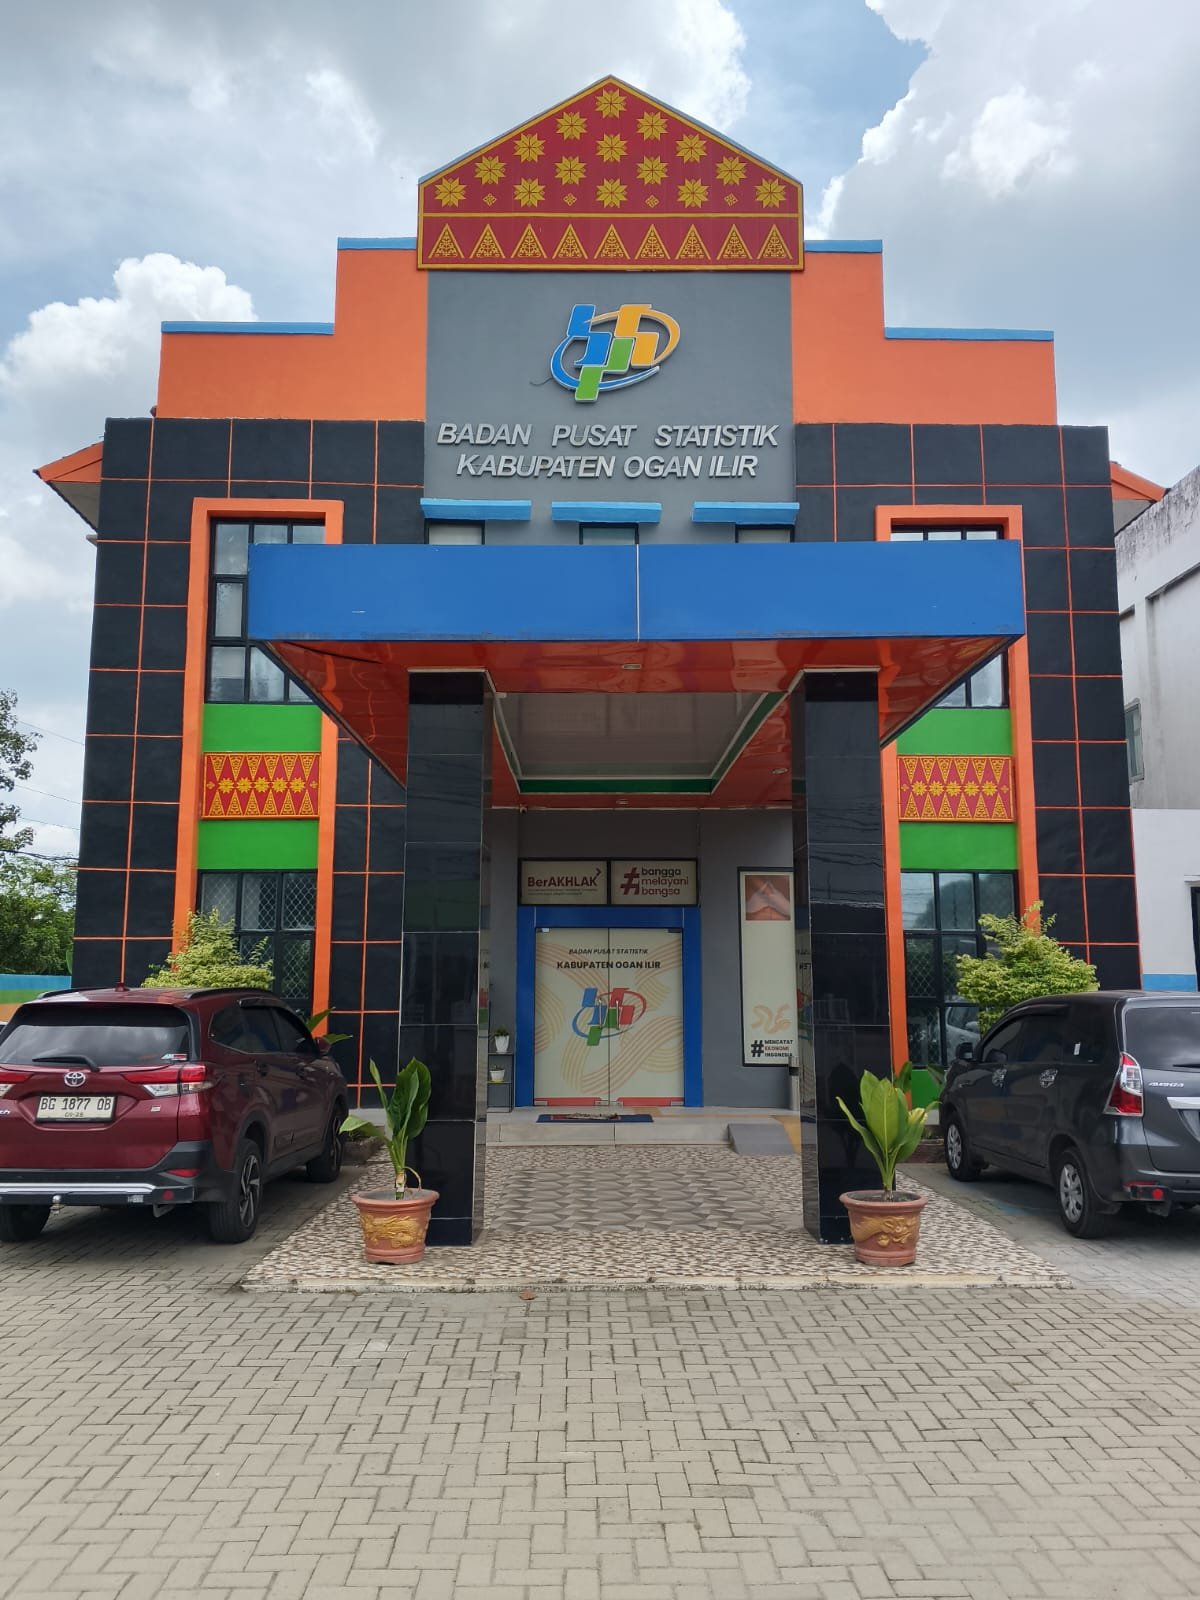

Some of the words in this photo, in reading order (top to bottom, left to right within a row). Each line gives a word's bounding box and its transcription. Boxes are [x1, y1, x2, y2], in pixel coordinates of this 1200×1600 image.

[436, 422, 532, 446] BADAN
[551, 423, 638, 448] PUSAT
[654, 424, 780, 448] STATISTIK
[456, 453, 616, 479] KABUPATEN
[623, 455, 703, 479] OGAN
[708, 455, 759, 478] ILIR
[641, 866, 681, 878] bangga
[527, 876, 597, 888] BerAKHLAK
[641, 876, 689, 888] melayani
[641, 886, 681, 898] bangsa
[557, 961, 613, 969] KABUPATEN
[615, 961, 643, 969] OGAN
[644, 961, 661, 969] ILIR
[41, 1098, 56, 1110] BG
[62, 1098, 90, 1110] 1877
